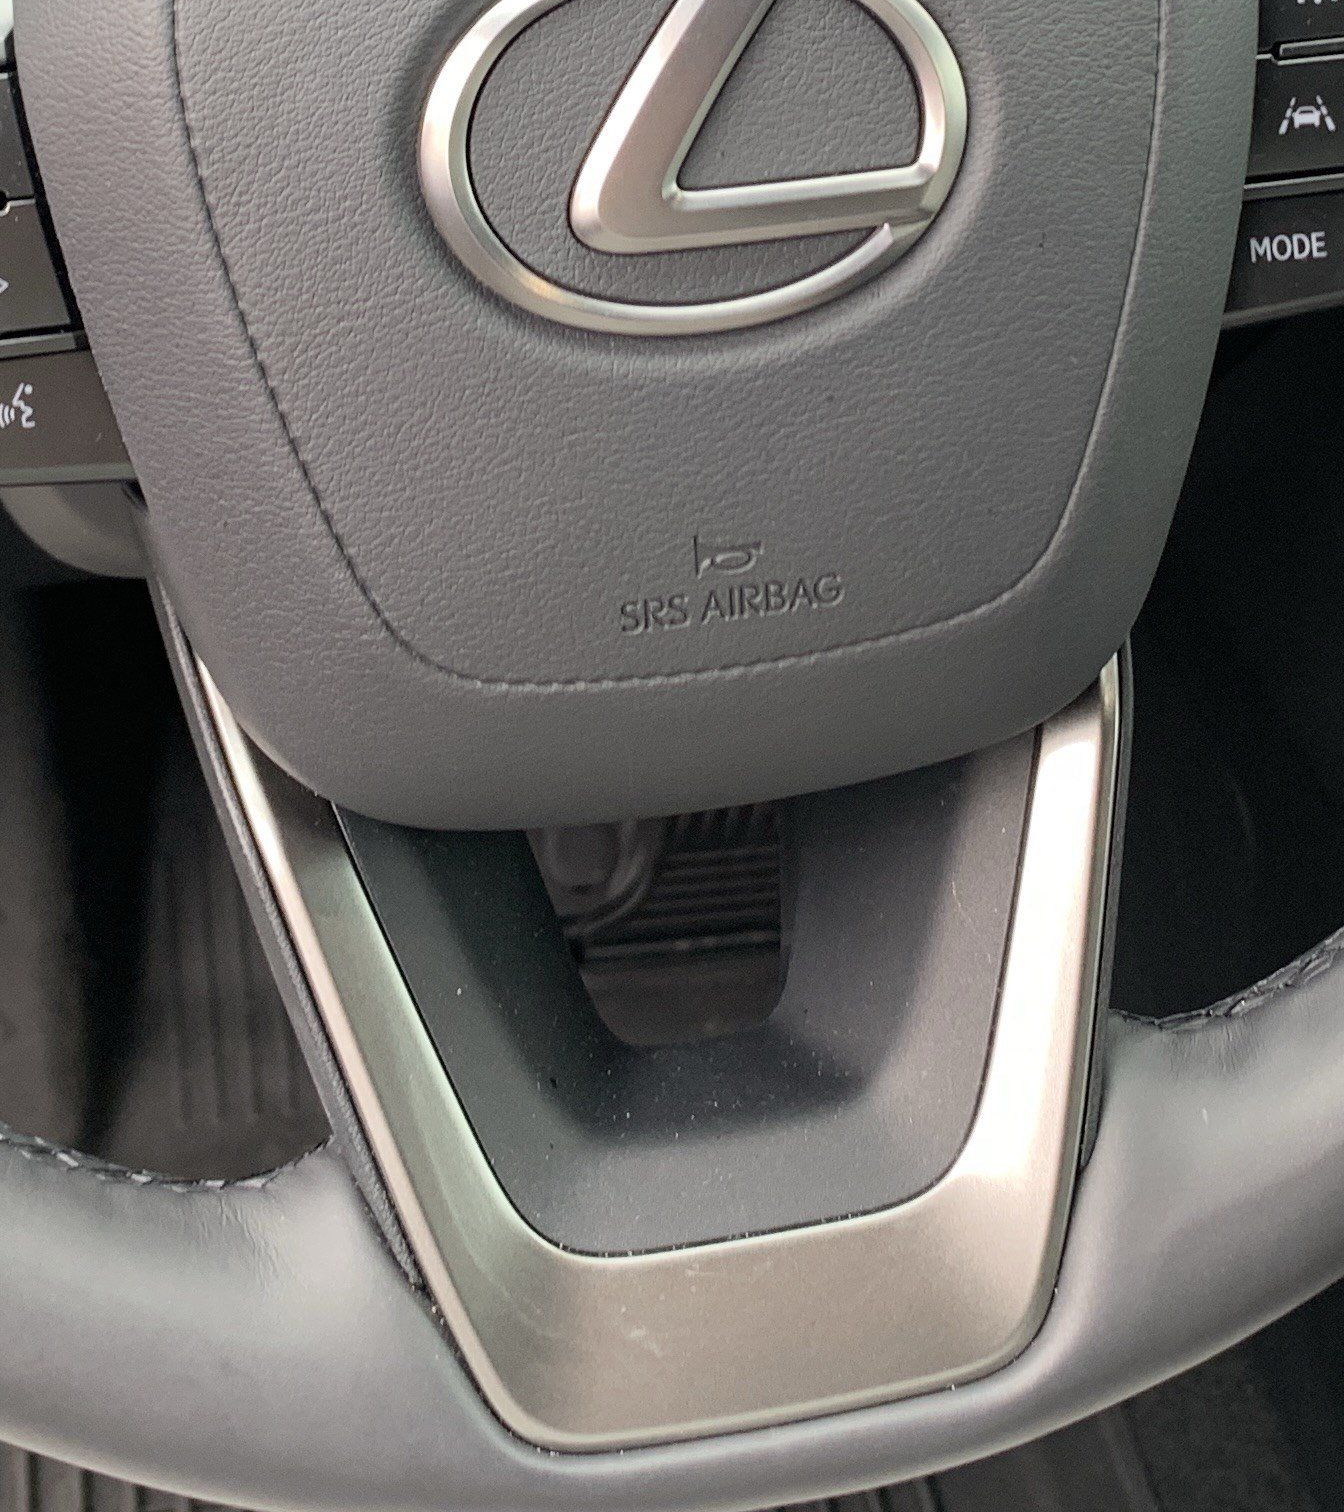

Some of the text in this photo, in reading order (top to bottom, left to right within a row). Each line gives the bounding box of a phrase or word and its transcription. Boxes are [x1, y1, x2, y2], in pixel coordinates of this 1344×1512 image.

[1249, 231, 1328, 263] MODE
[619, 572, 845, 635] SRS AIRBAG
